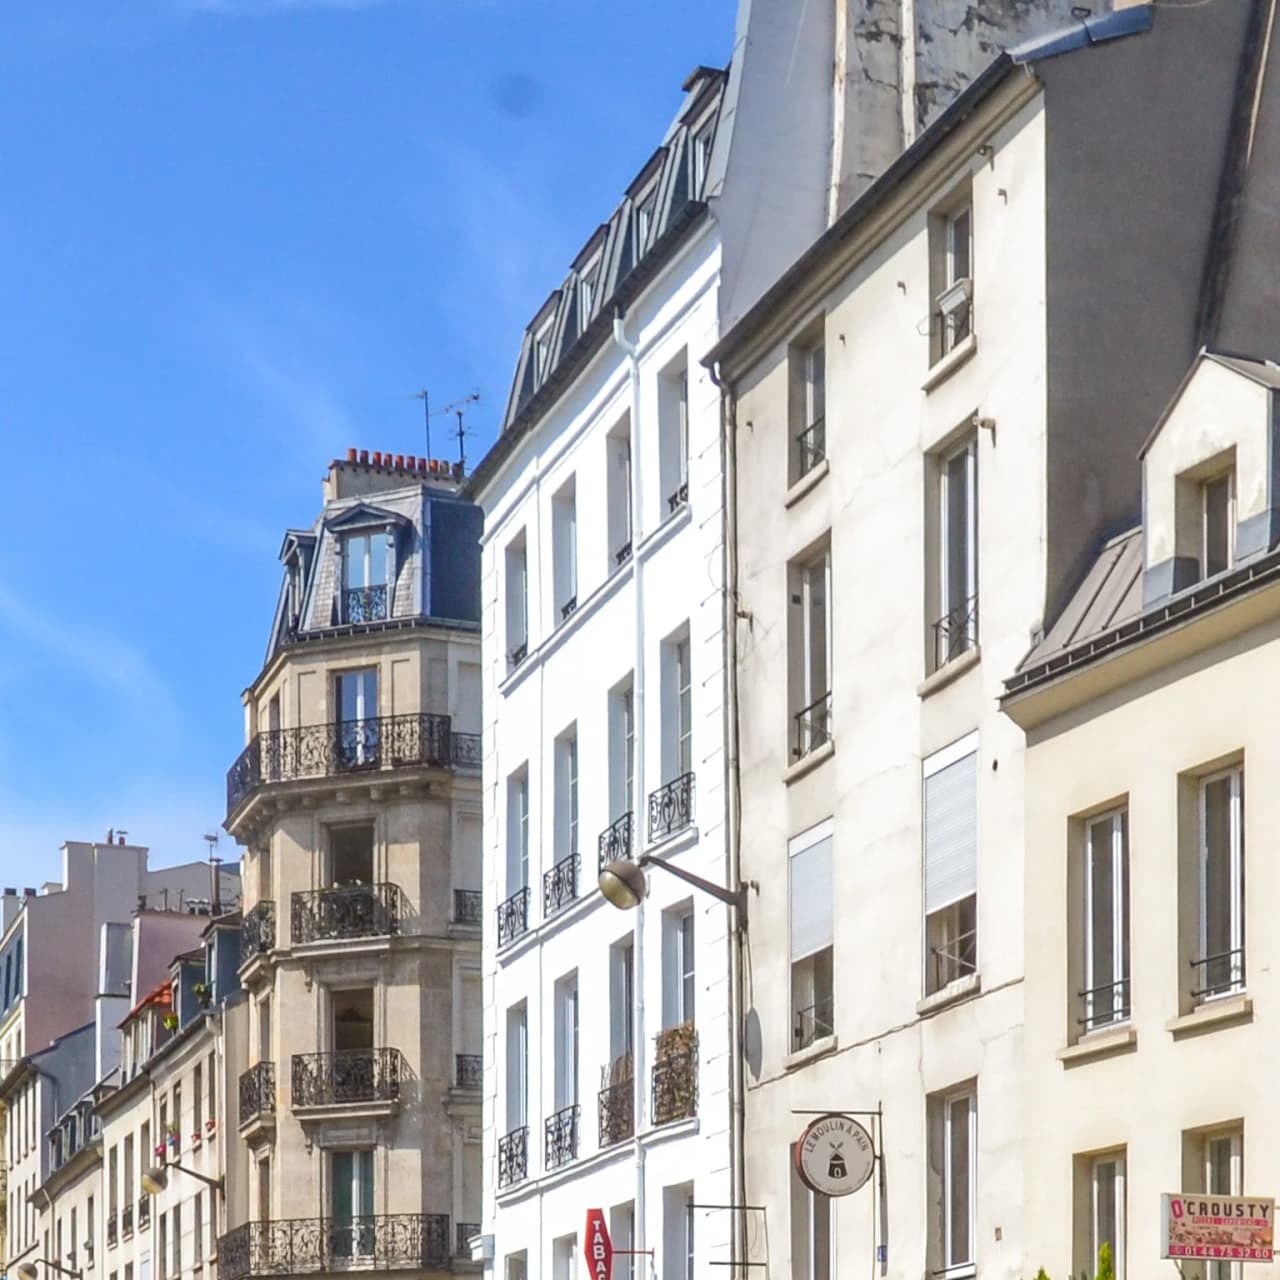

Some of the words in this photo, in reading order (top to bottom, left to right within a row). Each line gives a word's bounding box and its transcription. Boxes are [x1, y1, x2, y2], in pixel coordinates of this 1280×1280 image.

[810, 1120, 844, 1141] MOULIN
[805, 1140, 816, 1153] LE
[853, 1130, 870, 1152] PAIN
[1171, 1199, 1269, 1219] O'CROUSTY
[1185, 1246, 1197, 1256] 01
[1201, 1247, 1214, 1257] 44
